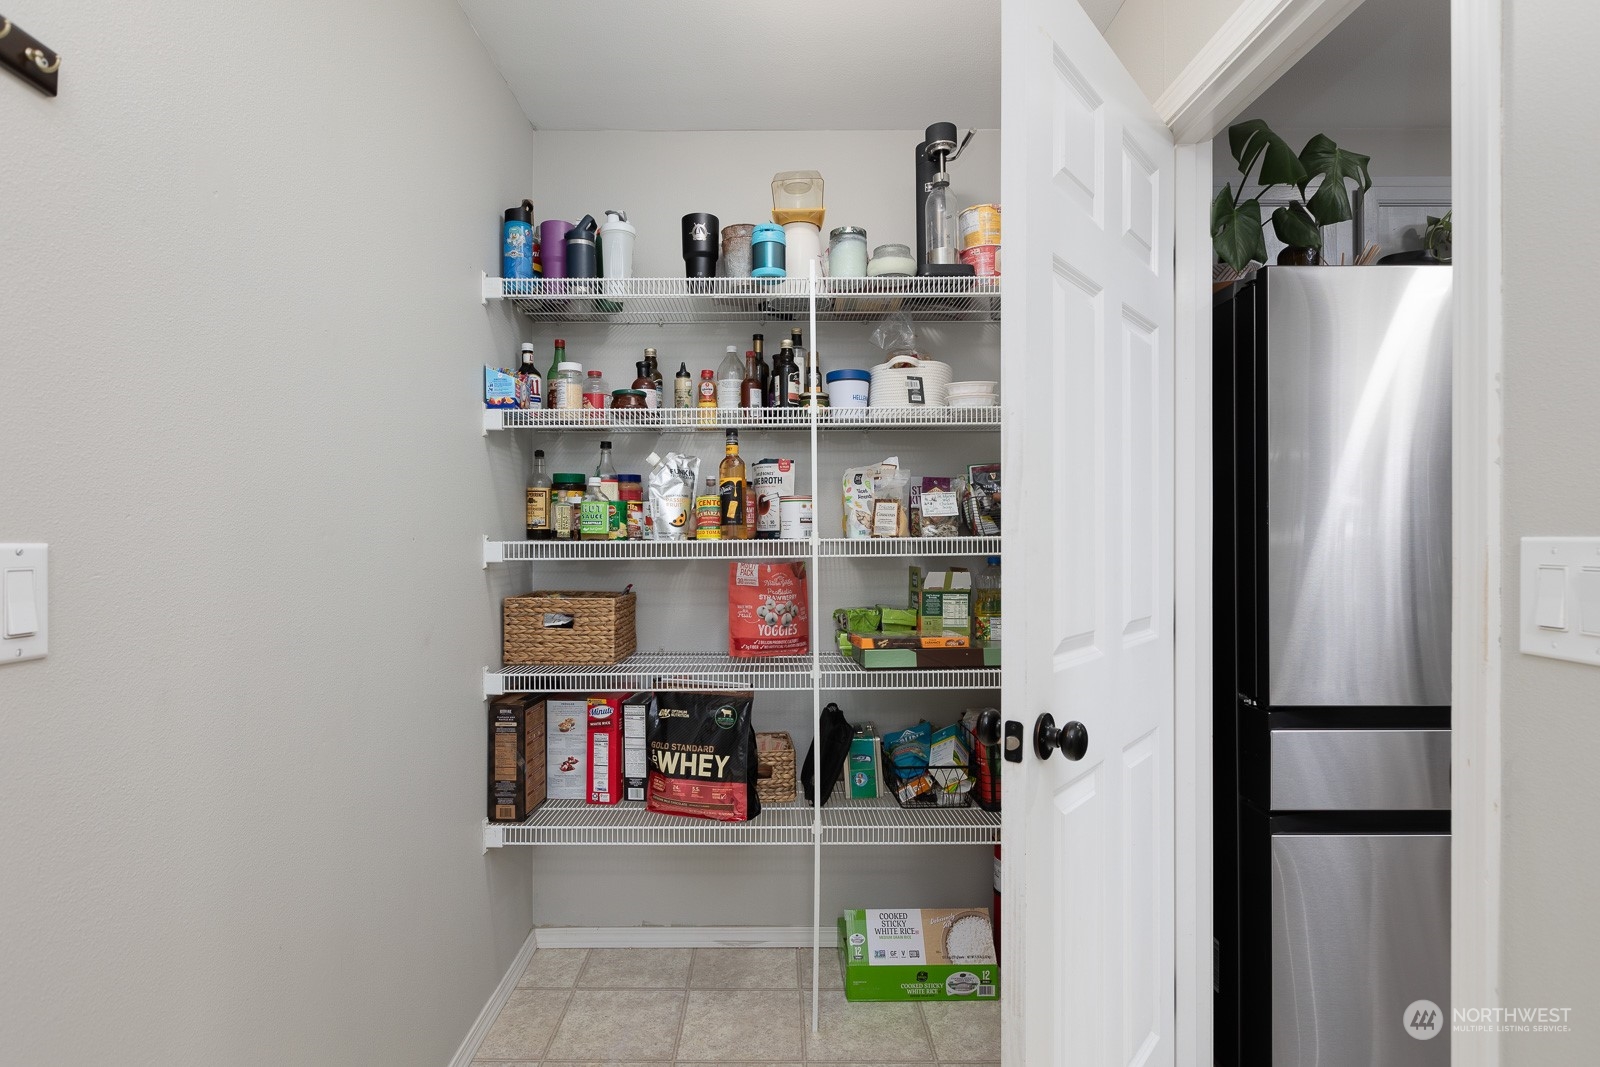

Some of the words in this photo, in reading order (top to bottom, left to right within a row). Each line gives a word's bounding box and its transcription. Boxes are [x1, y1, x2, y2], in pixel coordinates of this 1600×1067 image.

[669, 468, 695, 477] FUNKIN
[582, 503, 604, 513] HOT
[740, 568, 755, 577] PACK
[758, 624, 798, 637] YOGGIES
[650, 741, 669, 750] GOLD
[671, 743, 715, 753] STANDARD
[657, 750, 730, 778] WHEY
[881, 920, 907, 928] STICKY
[874, 927, 899, 935] WHITE
[899, 927, 916, 935] RICE
[854, 946, 862, 956] 12
[982, 969, 991, 980] 12
